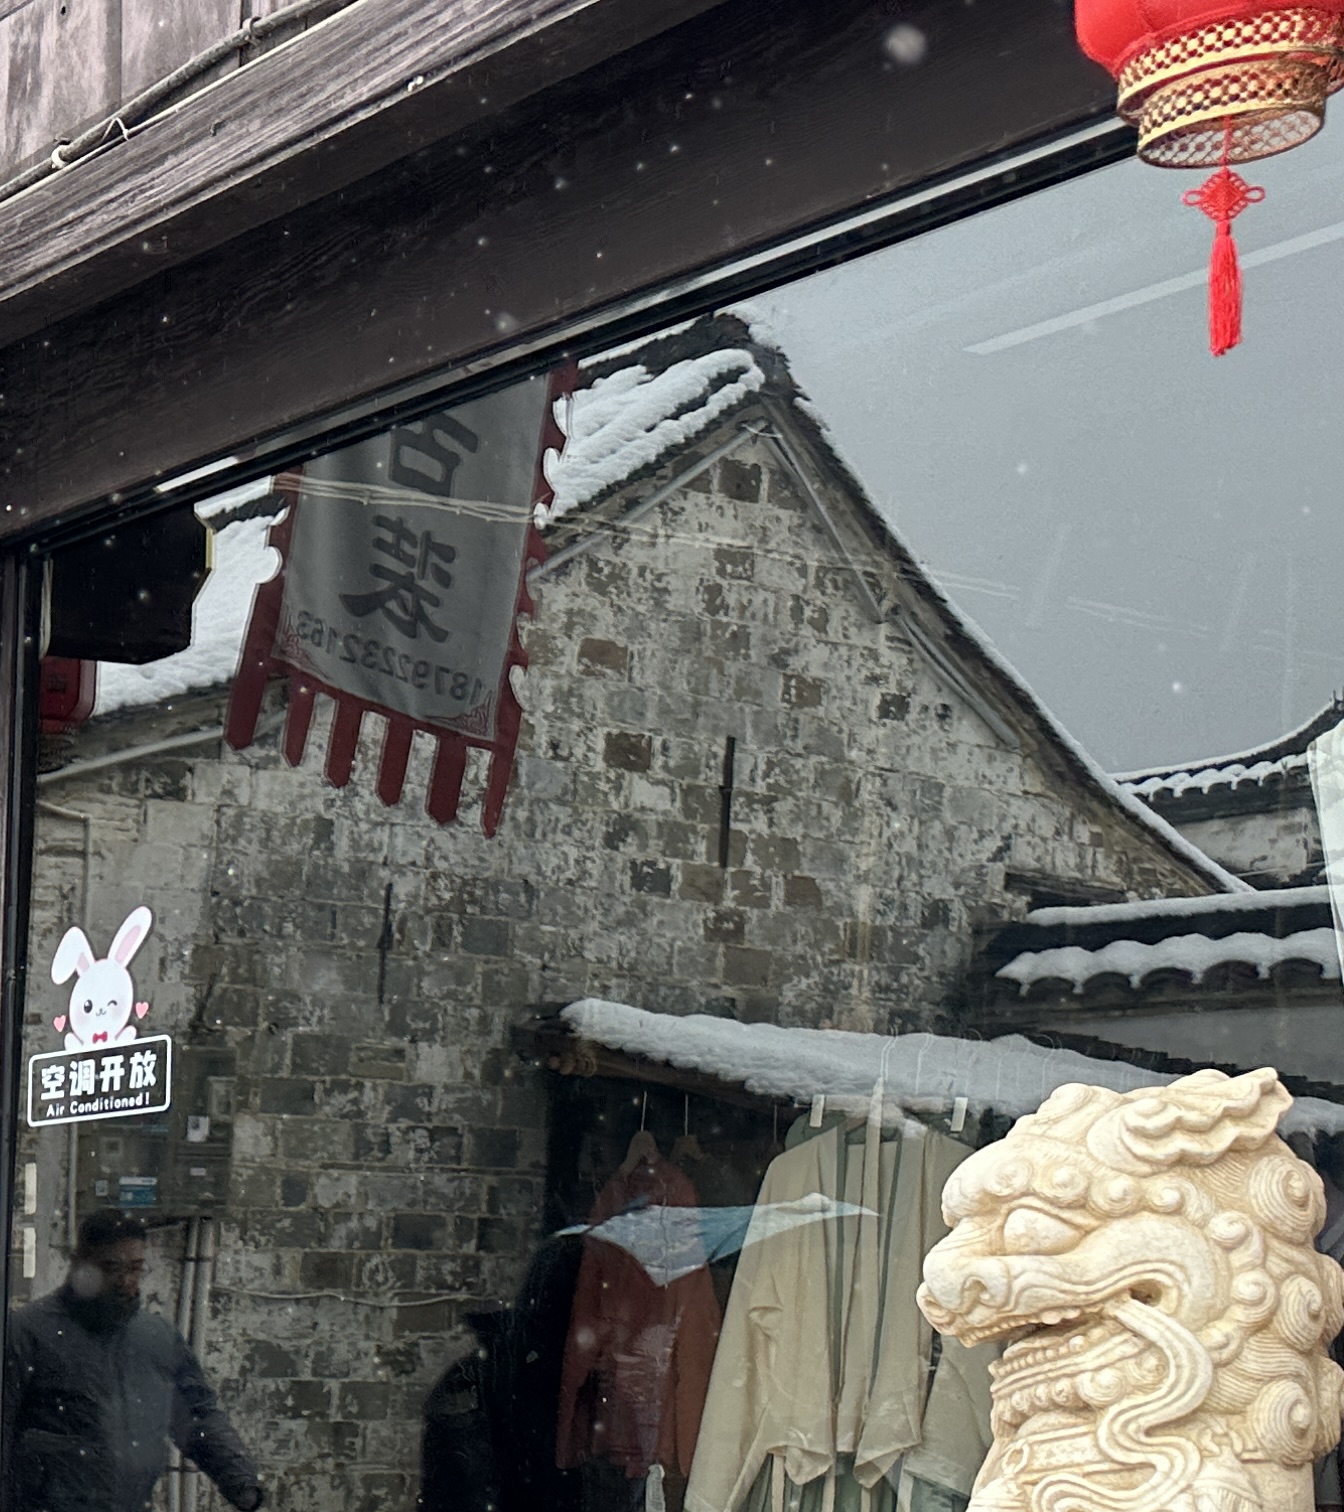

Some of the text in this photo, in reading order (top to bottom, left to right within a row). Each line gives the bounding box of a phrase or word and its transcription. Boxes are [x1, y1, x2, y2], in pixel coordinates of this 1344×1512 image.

[40, 1050, 157, 1100] 空调开放
[46, 1091, 150, 1118] Air Conditioned!
